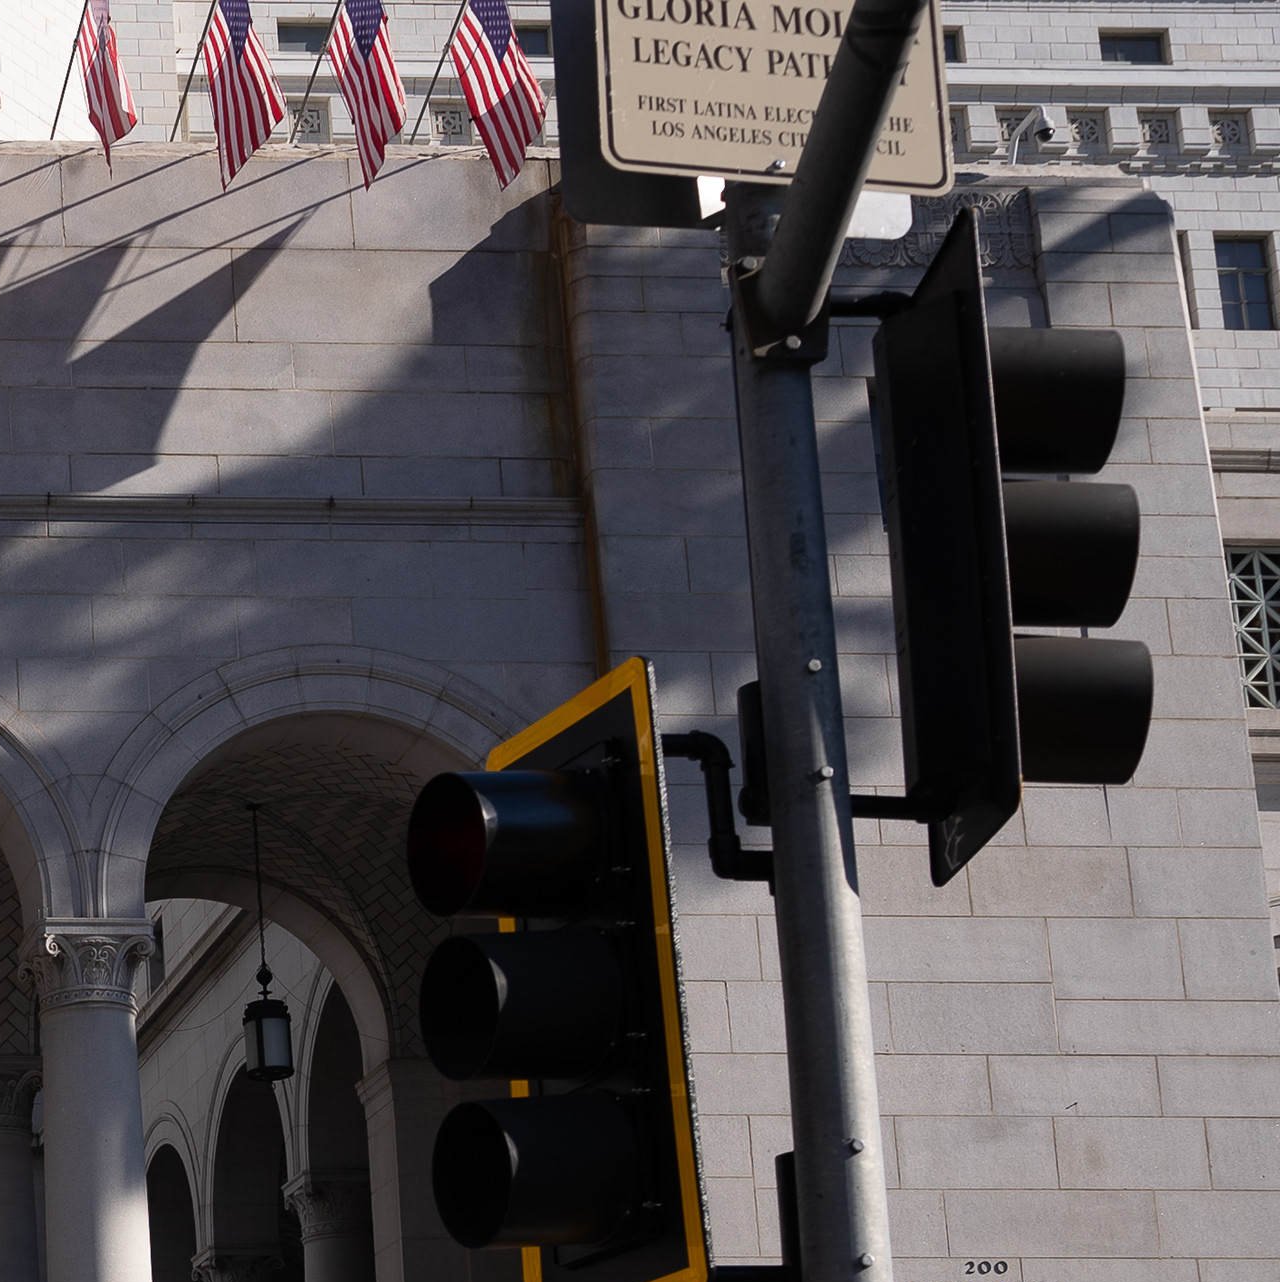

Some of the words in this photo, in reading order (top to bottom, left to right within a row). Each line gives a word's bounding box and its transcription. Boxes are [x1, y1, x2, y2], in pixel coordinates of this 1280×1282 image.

[633, 36, 754, 72] LEGACY
[638, 95, 688, 115] FIRST
[693, 100, 757, 121] LATINA
[652, 120, 685, 138] LOS
[691, 126, 772, 146] ANGELES
[965, 1261, 1009, 1275] 200
